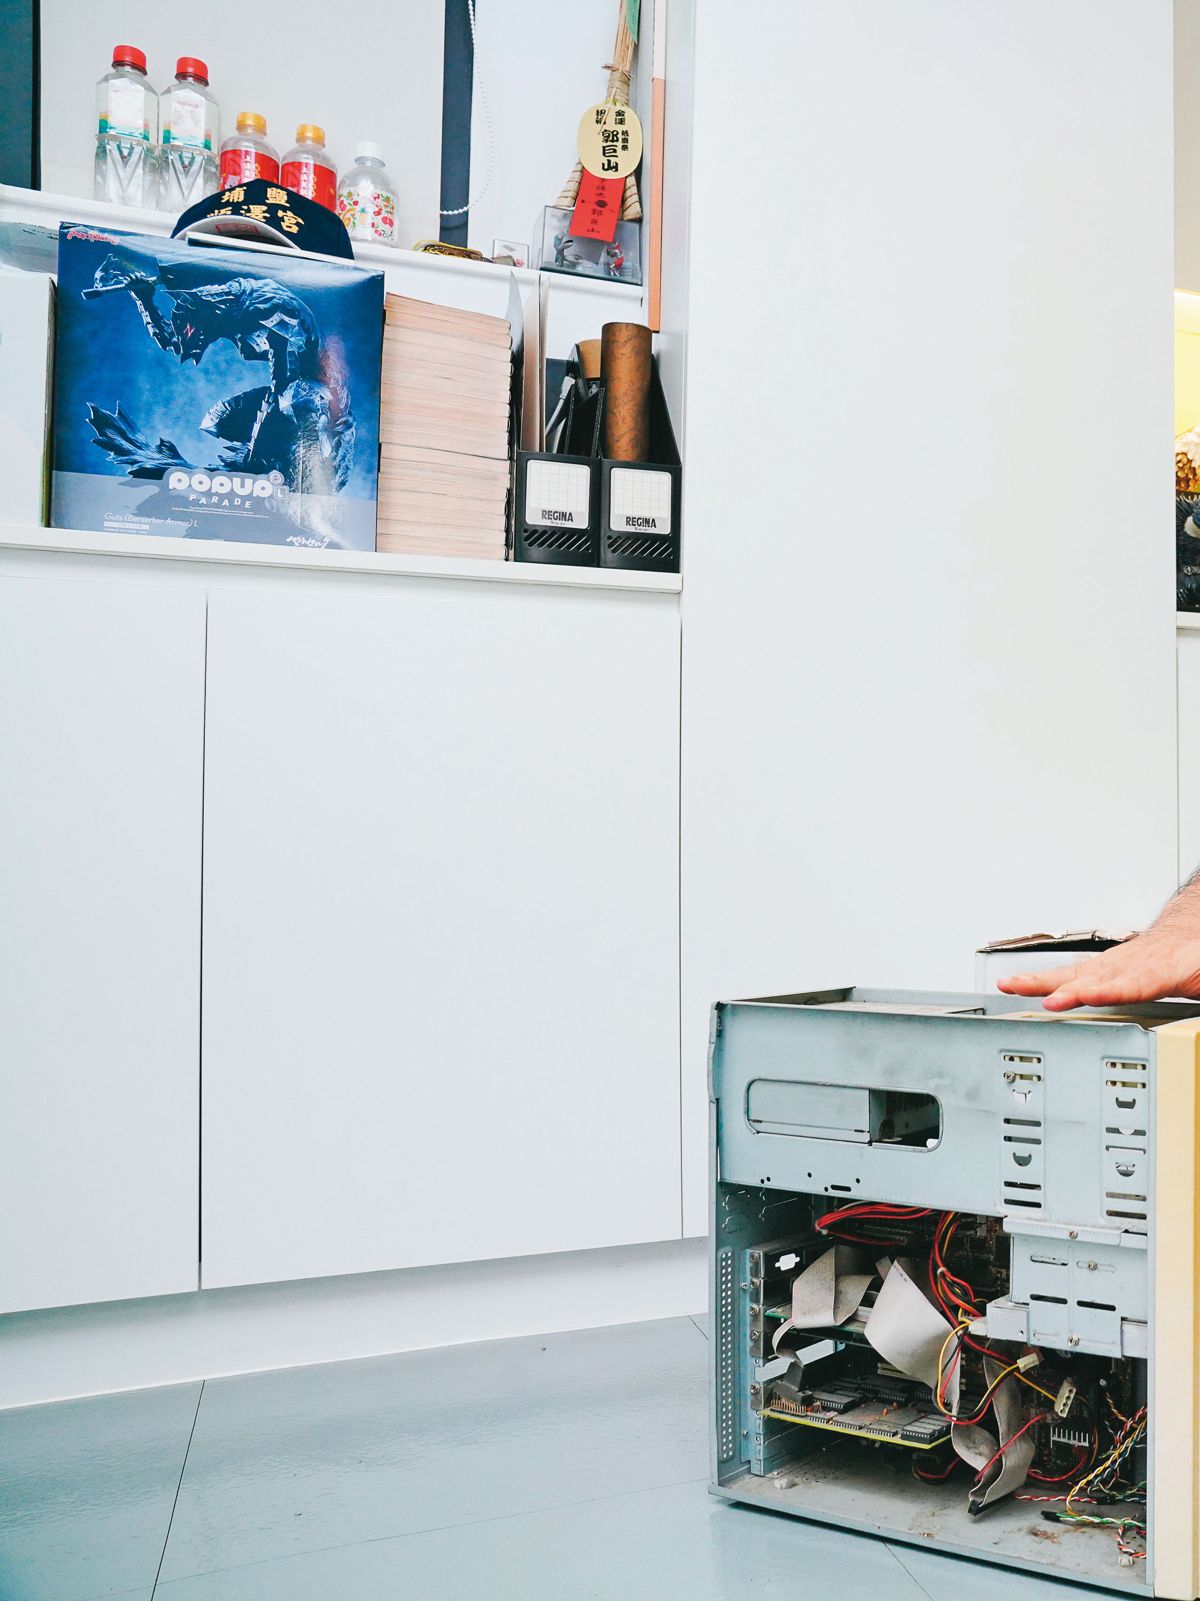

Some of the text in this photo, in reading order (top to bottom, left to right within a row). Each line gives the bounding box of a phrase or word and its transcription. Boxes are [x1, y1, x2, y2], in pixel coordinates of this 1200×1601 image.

[601, 129, 619, 172] 郭巨山
[168, 471, 273, 498] POPUP
[189, 494, 252, 508] PARADE
[541, 509, 574, 523] REGINA
[625, 516, 657, 528] REGINA
